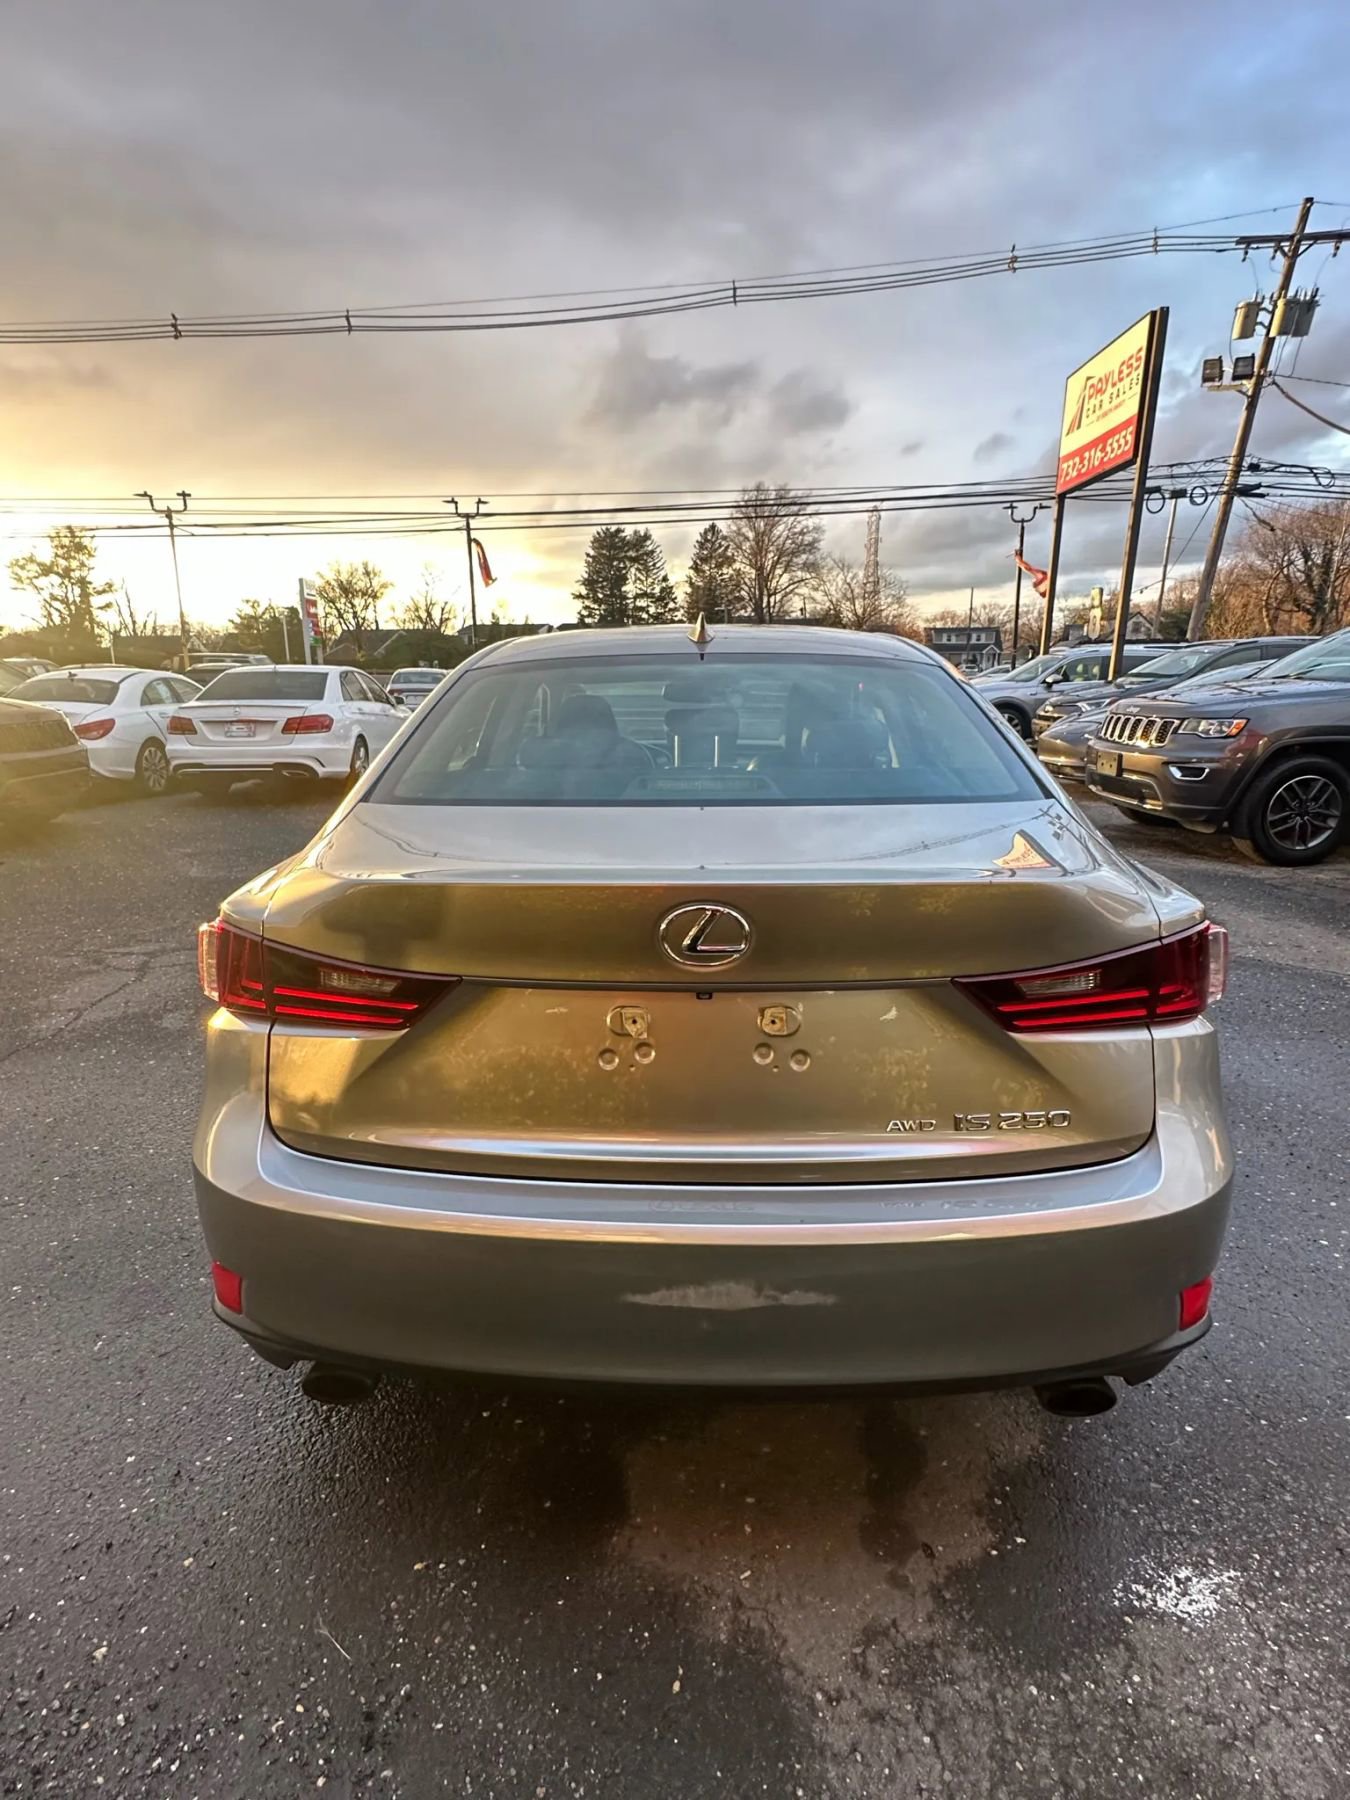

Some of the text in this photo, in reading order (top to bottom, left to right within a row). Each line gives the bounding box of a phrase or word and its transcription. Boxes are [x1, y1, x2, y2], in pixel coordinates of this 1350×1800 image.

[1085, 399, 1103, 419] CAR
[1109, 373, 1140, 405] SALES
[1087, 346, 1144, 405] PAYLESS
[1061, 425, 1133, 484] 732-316-5555
[886, 1110, 1071, 1133] AWD IS 250
